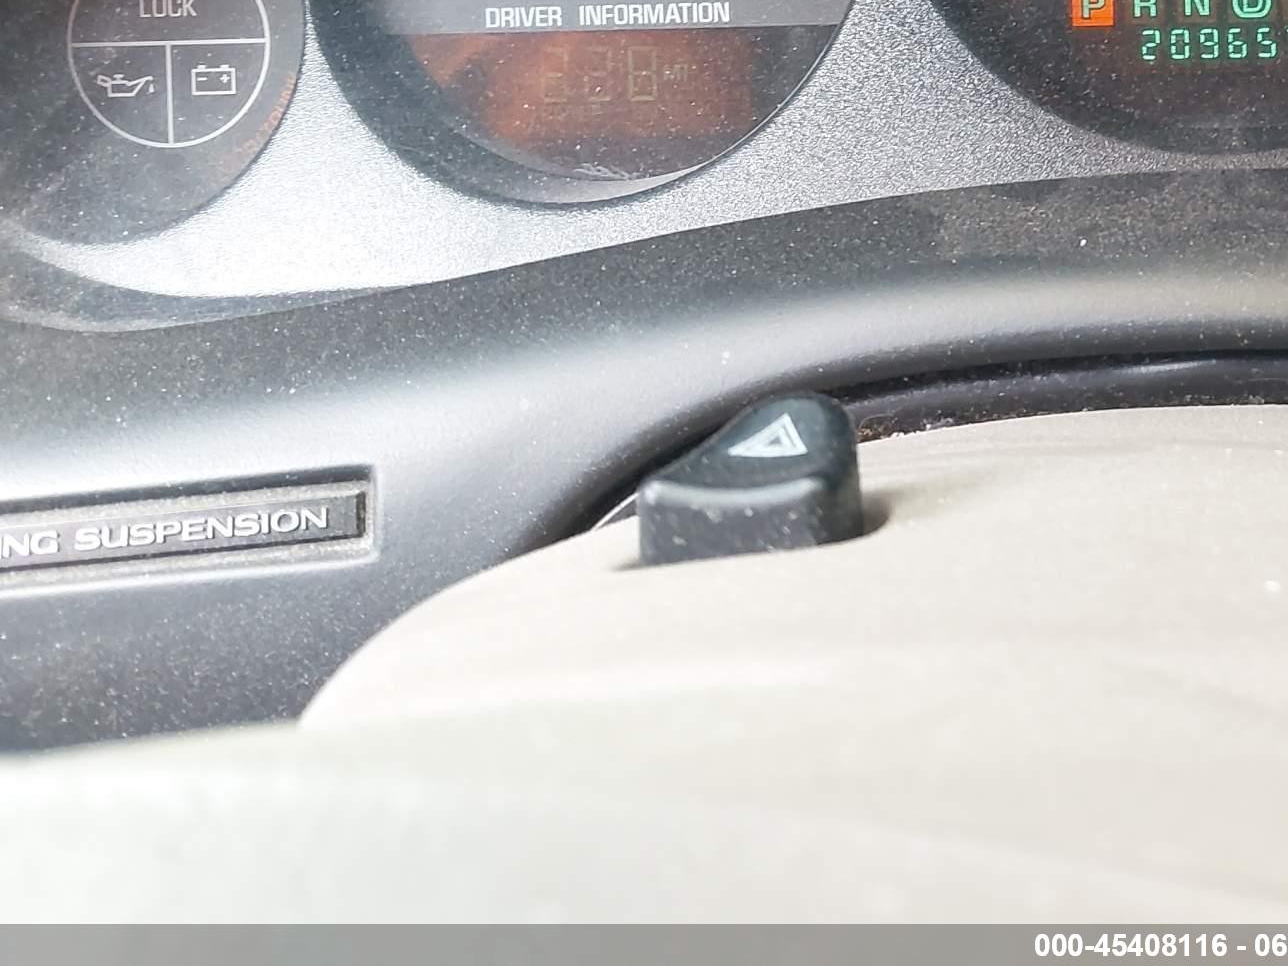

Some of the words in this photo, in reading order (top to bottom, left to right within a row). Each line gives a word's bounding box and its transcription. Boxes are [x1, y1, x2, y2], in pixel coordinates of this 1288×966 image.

[485, 6, 562, 29] DRIVER
[578, 2, 730, 26] INFORMATION
[0, 530, 59, 559] NG
[74, 506, 329, 552] SUSPENSION
